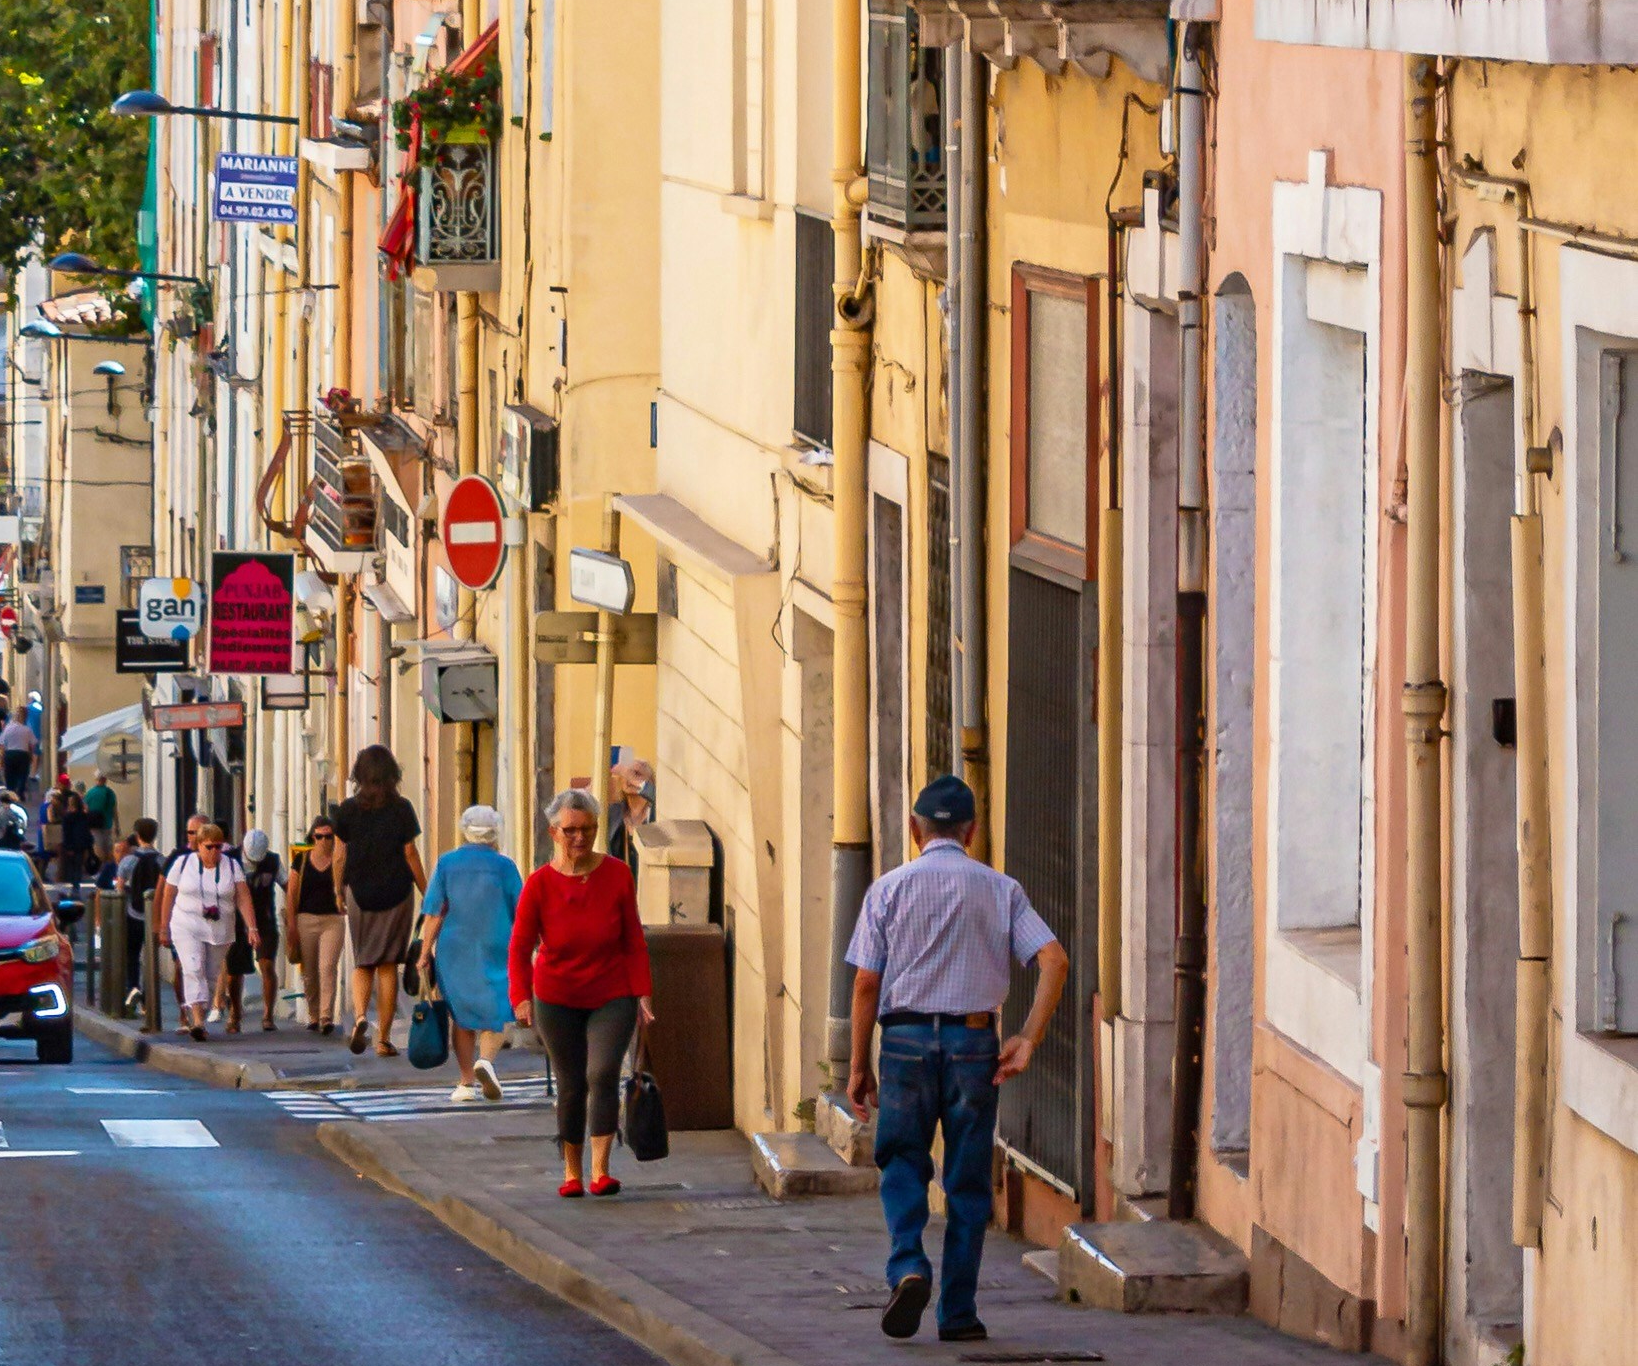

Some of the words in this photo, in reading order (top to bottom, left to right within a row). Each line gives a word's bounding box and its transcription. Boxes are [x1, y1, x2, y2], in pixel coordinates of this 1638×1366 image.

[220, 156, 297, 175] MARIANNE
[225, 186, 234, 198] A
[239, 187, 289, 201] VENDRE
[224, 583, 282, 599] PUNJAB
[146, 598, 195, 622] gan
[212, 602, 291, 621] RESTAURANT
